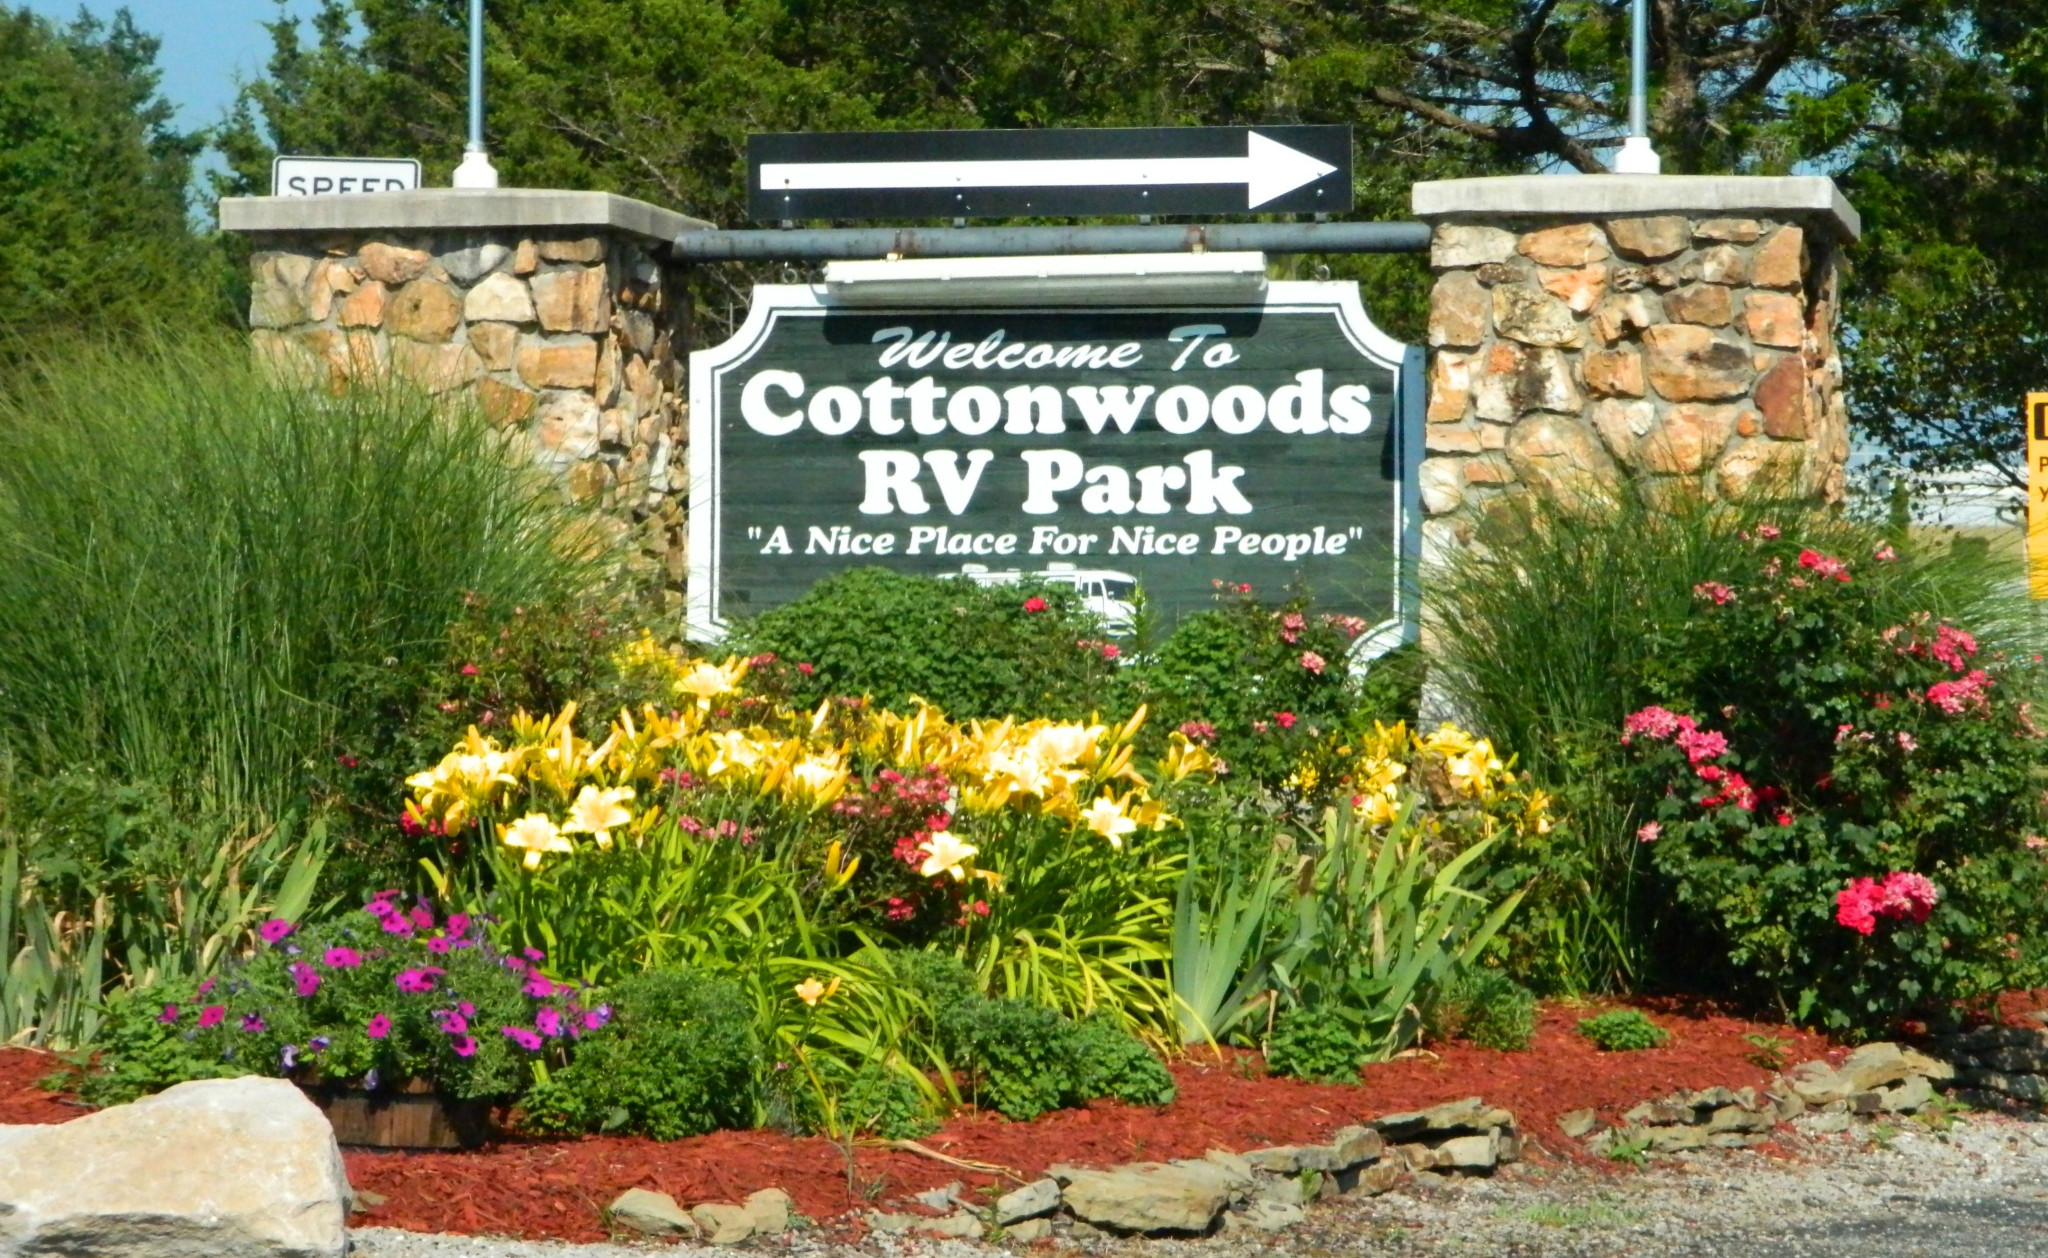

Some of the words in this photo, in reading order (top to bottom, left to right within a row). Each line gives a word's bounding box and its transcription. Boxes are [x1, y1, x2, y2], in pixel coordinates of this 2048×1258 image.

[871, 326, 1143, 369] Welcome
[1168, 324, 1240, 371] To
[739, 368, 1373, 436] Cottonwoods
[858, 449, 994, 515] RV
[1020, 449, 1253, 515] Park
[747, 527, 793, 555] "A
[805, 526, 894, 555] Nice
[907, 526, 1017, 555] Place
[1030, 527, 1099, 555] For
[1109, 526, 1199, 555] Nice
[1212, 526, 1363, 561] People"
